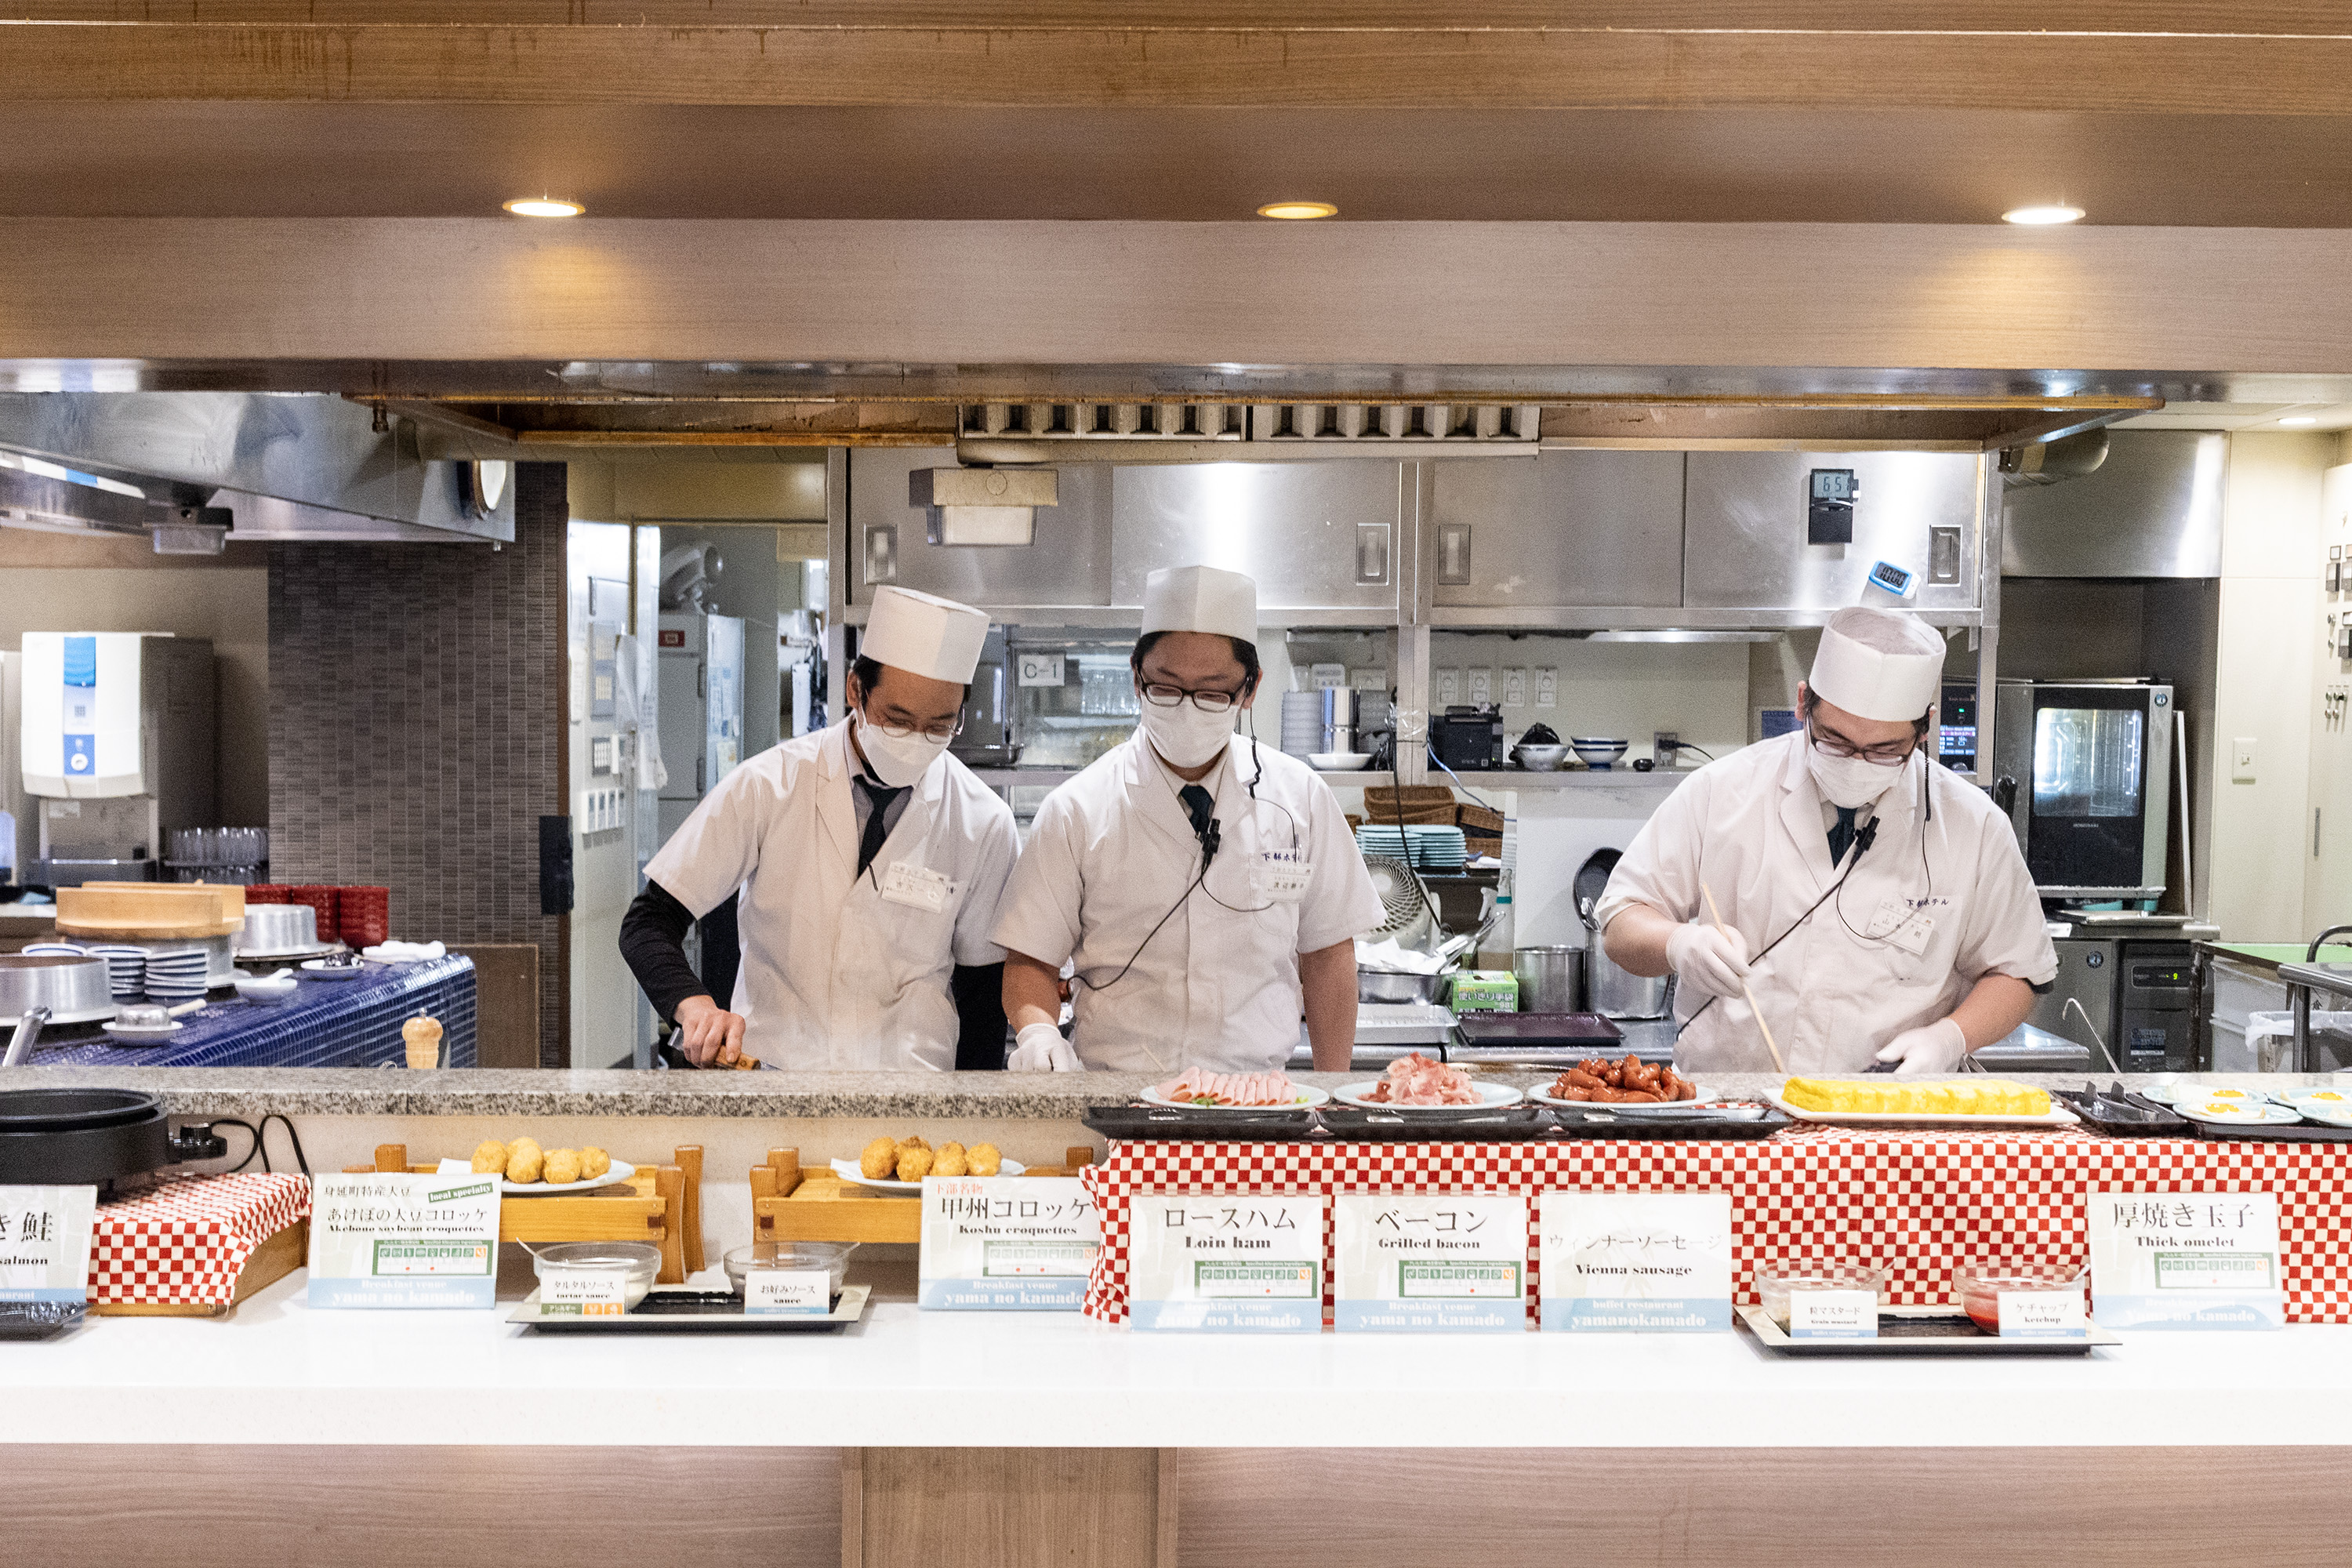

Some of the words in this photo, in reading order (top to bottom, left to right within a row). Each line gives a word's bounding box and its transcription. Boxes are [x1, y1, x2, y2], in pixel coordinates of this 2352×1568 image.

[430, 1190, 452, 1202] local
[453, 1184, 492, 1199] specialty
[327, 1207, 488, 1223] あけぼの大豆コロッケ
[942, 1197, 1091, 1221] 甲州コロッケ
[1165, 1207, 1296, 1229] ロースハム
[1375, 1209, 1488, 1233] ベーコン
[2114, 1202, 2255, 1229] 厚焼き玉子
[328, 1225, 375, 1233] Akebono
[379, 1225, 423, 1235] soybean
[426, 1225, 485, 1234] croquettes
[959, 1225, 1001, 1234] Koshu
[1006, 1225, 1077, 1236] croquettes
[1185, 1236, 1226, 1248] Loin
[1233, 1236, 1271, 1248] ham
[1378, 1238, 1431, 1249] Grilled
[1437, 1239, 1480, 1249] bacon
[1549, 1234, 1722, 1250] ウィンナーソーセージ
[2135, 1236, 2178, 1247] Thick
[2184, 1236, 2235, 1247] omelet
[1576, 1264, 1628, 1275] Vienna
[1632, 1265, 1693, 1277] sausage
[361, 1279, 413, 1289] Breakfast
[416, 1281, 447, 1290] venue
[554, 1281, 614, 1290] タルタルソース
[760, 1285, 815, 1294] お好みソース
[972, 1280, 1024, 1290] Breakfast
[332, 1293, 378, 1306] yama
[383, 1293, 404, 1303] no
[408, 1290, 476, 1303] kamado
[945, 1293, 989, 1307] yama
[994, 1293, 1015, 1304] no
[1240, 1302, 1272, 1312] venue
[1388, 1301, 1442, 1312] Breakfast
[1444, 1302, 1476, 1312] venue
[1592, 1300, 1624, 1309] buffet
[1628, 1300, 1684, 1309] restaurant
[2016, 1302, 2069, 1313] ケチャップ
[1810, 1306, 1861, 1316] 粒マスタード
[2197, 1309, 2256, 1323] kamado
[1207, 1315, 1228, 1327] no
[1233, 1312, 1301, 1327] kamado
[1359, 1314, 1406, 1329] yama
[1411, 1315, 1432, 1327] no
[1438, 1312, 1506, 1327] kamado
[1571, 1312, 1707, 1330] yamanokamado
